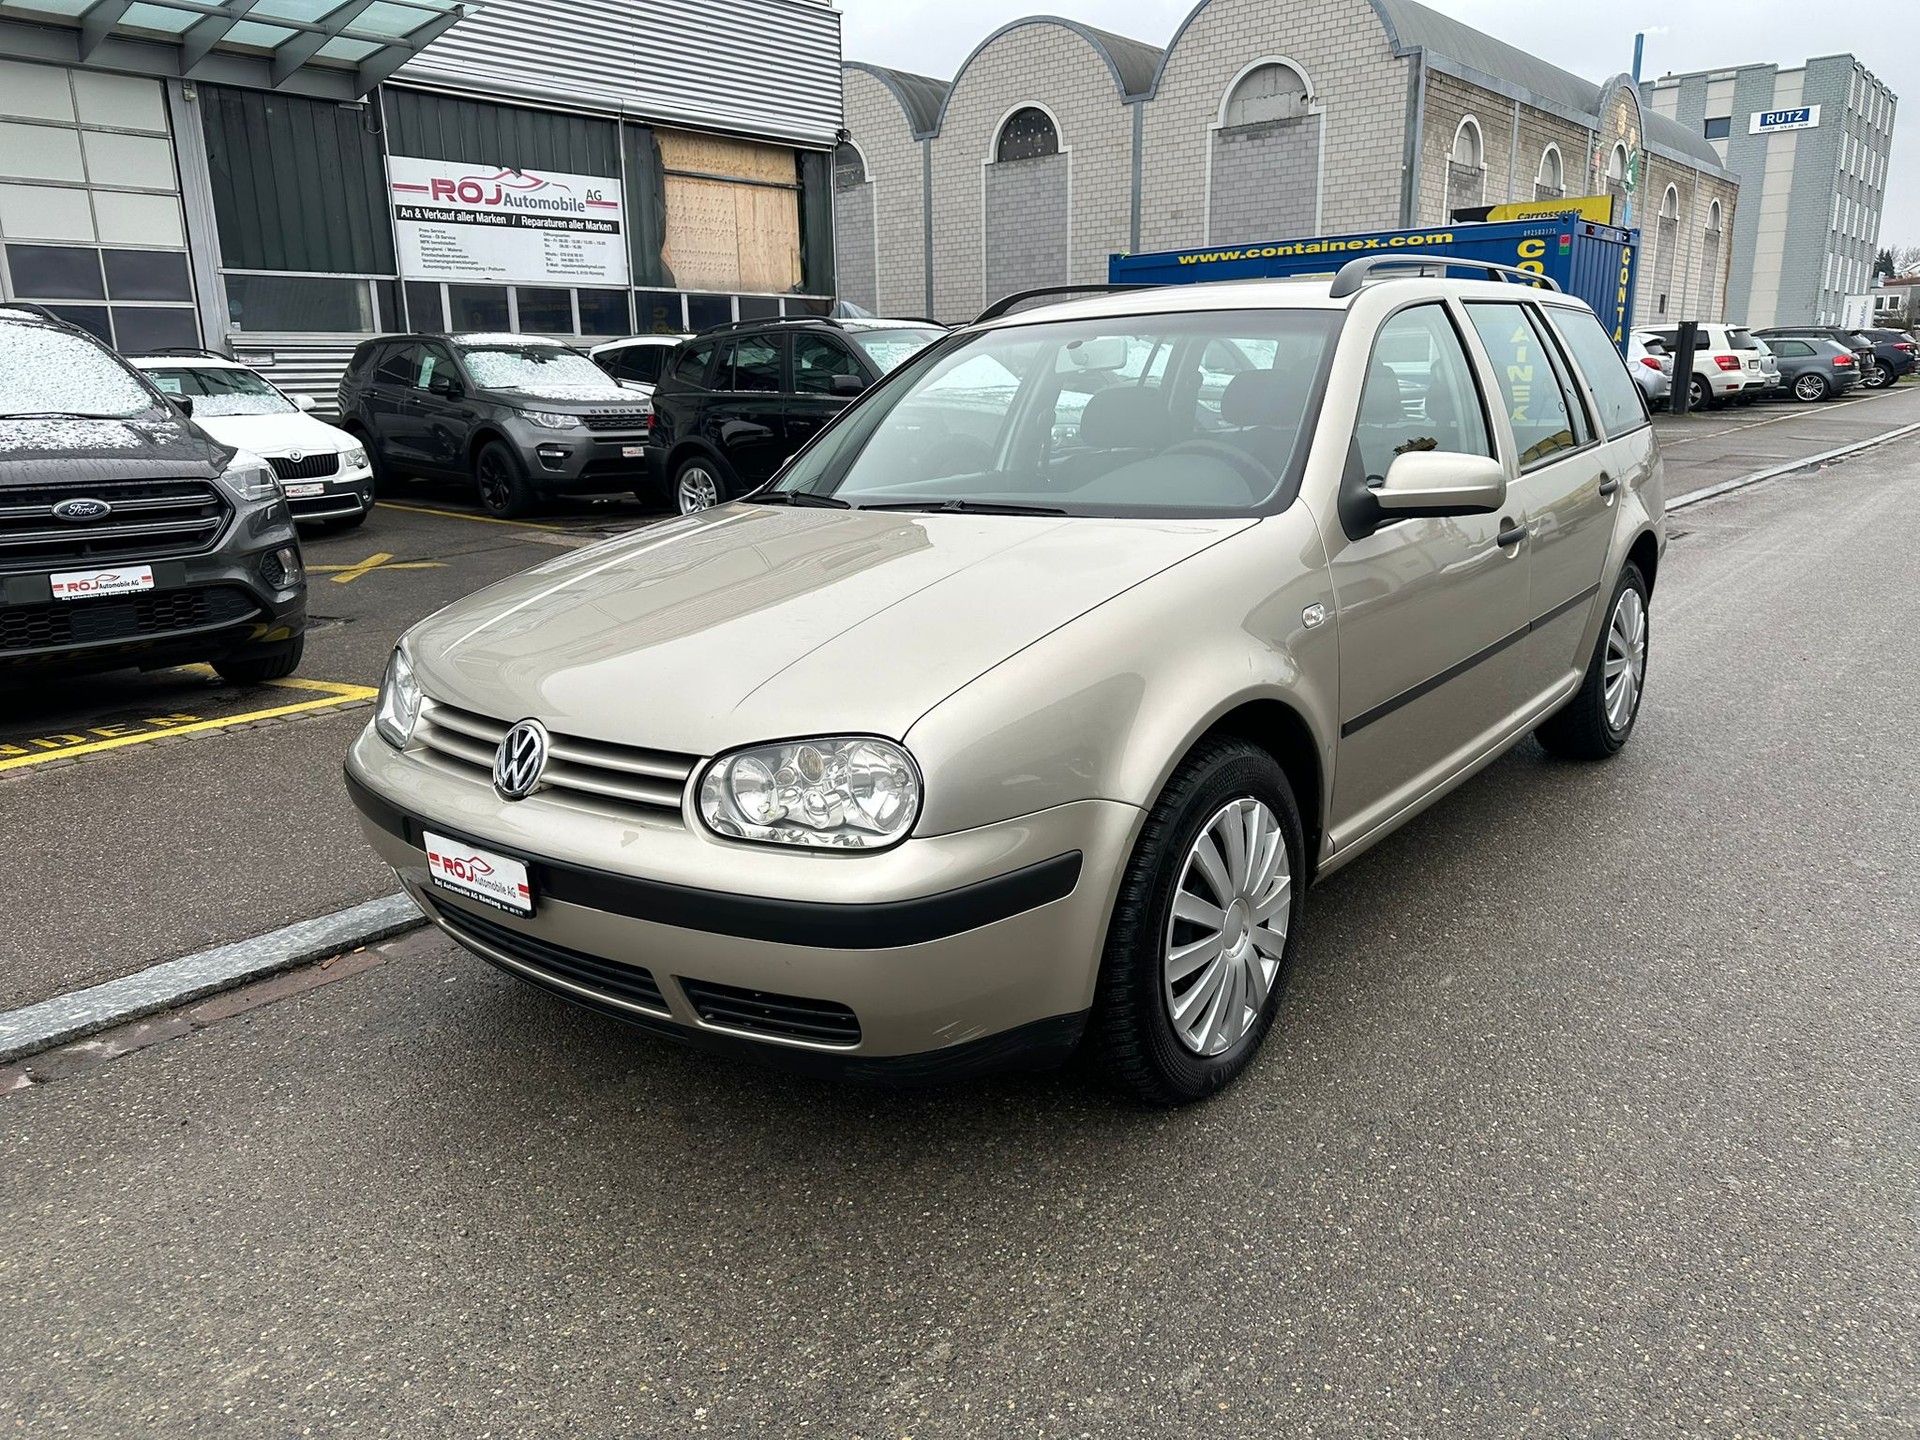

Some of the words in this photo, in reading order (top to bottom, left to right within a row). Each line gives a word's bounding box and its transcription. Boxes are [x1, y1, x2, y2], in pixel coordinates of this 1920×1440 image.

[1766, 111, 1803, 124] RUTZ
[431, 178, 502, 206] ROJ
[503, 192, 585, 212] Automobile
[586, 189, 602, 201] AG
[401, 207, 413, 218] An
[414, 208, 422, 218] &
[422, 208, 455, 221] Verkauf
[456, 211, 474, 222] aller
[476, 212, 506, 224] Marken
[521, 216, 567, 230] Reparaturen
[569, 220, 584, 230] aller
[585, 220, 612, 232] Marken
[1178, 233, 1453, 265] www.containex.com
[68, 503, 98, 516] Ford
[67, 580, 99, 592] ROJ
[99, 581, 130, 589] Automobile
[442, 856, 475, 882] ROJ
[474, 874, 507, 896] Automobile
[507, 885, 517, 898] AG
[443, 881, 470, 897] Automobile
[470, 891, 478, 900] AG
